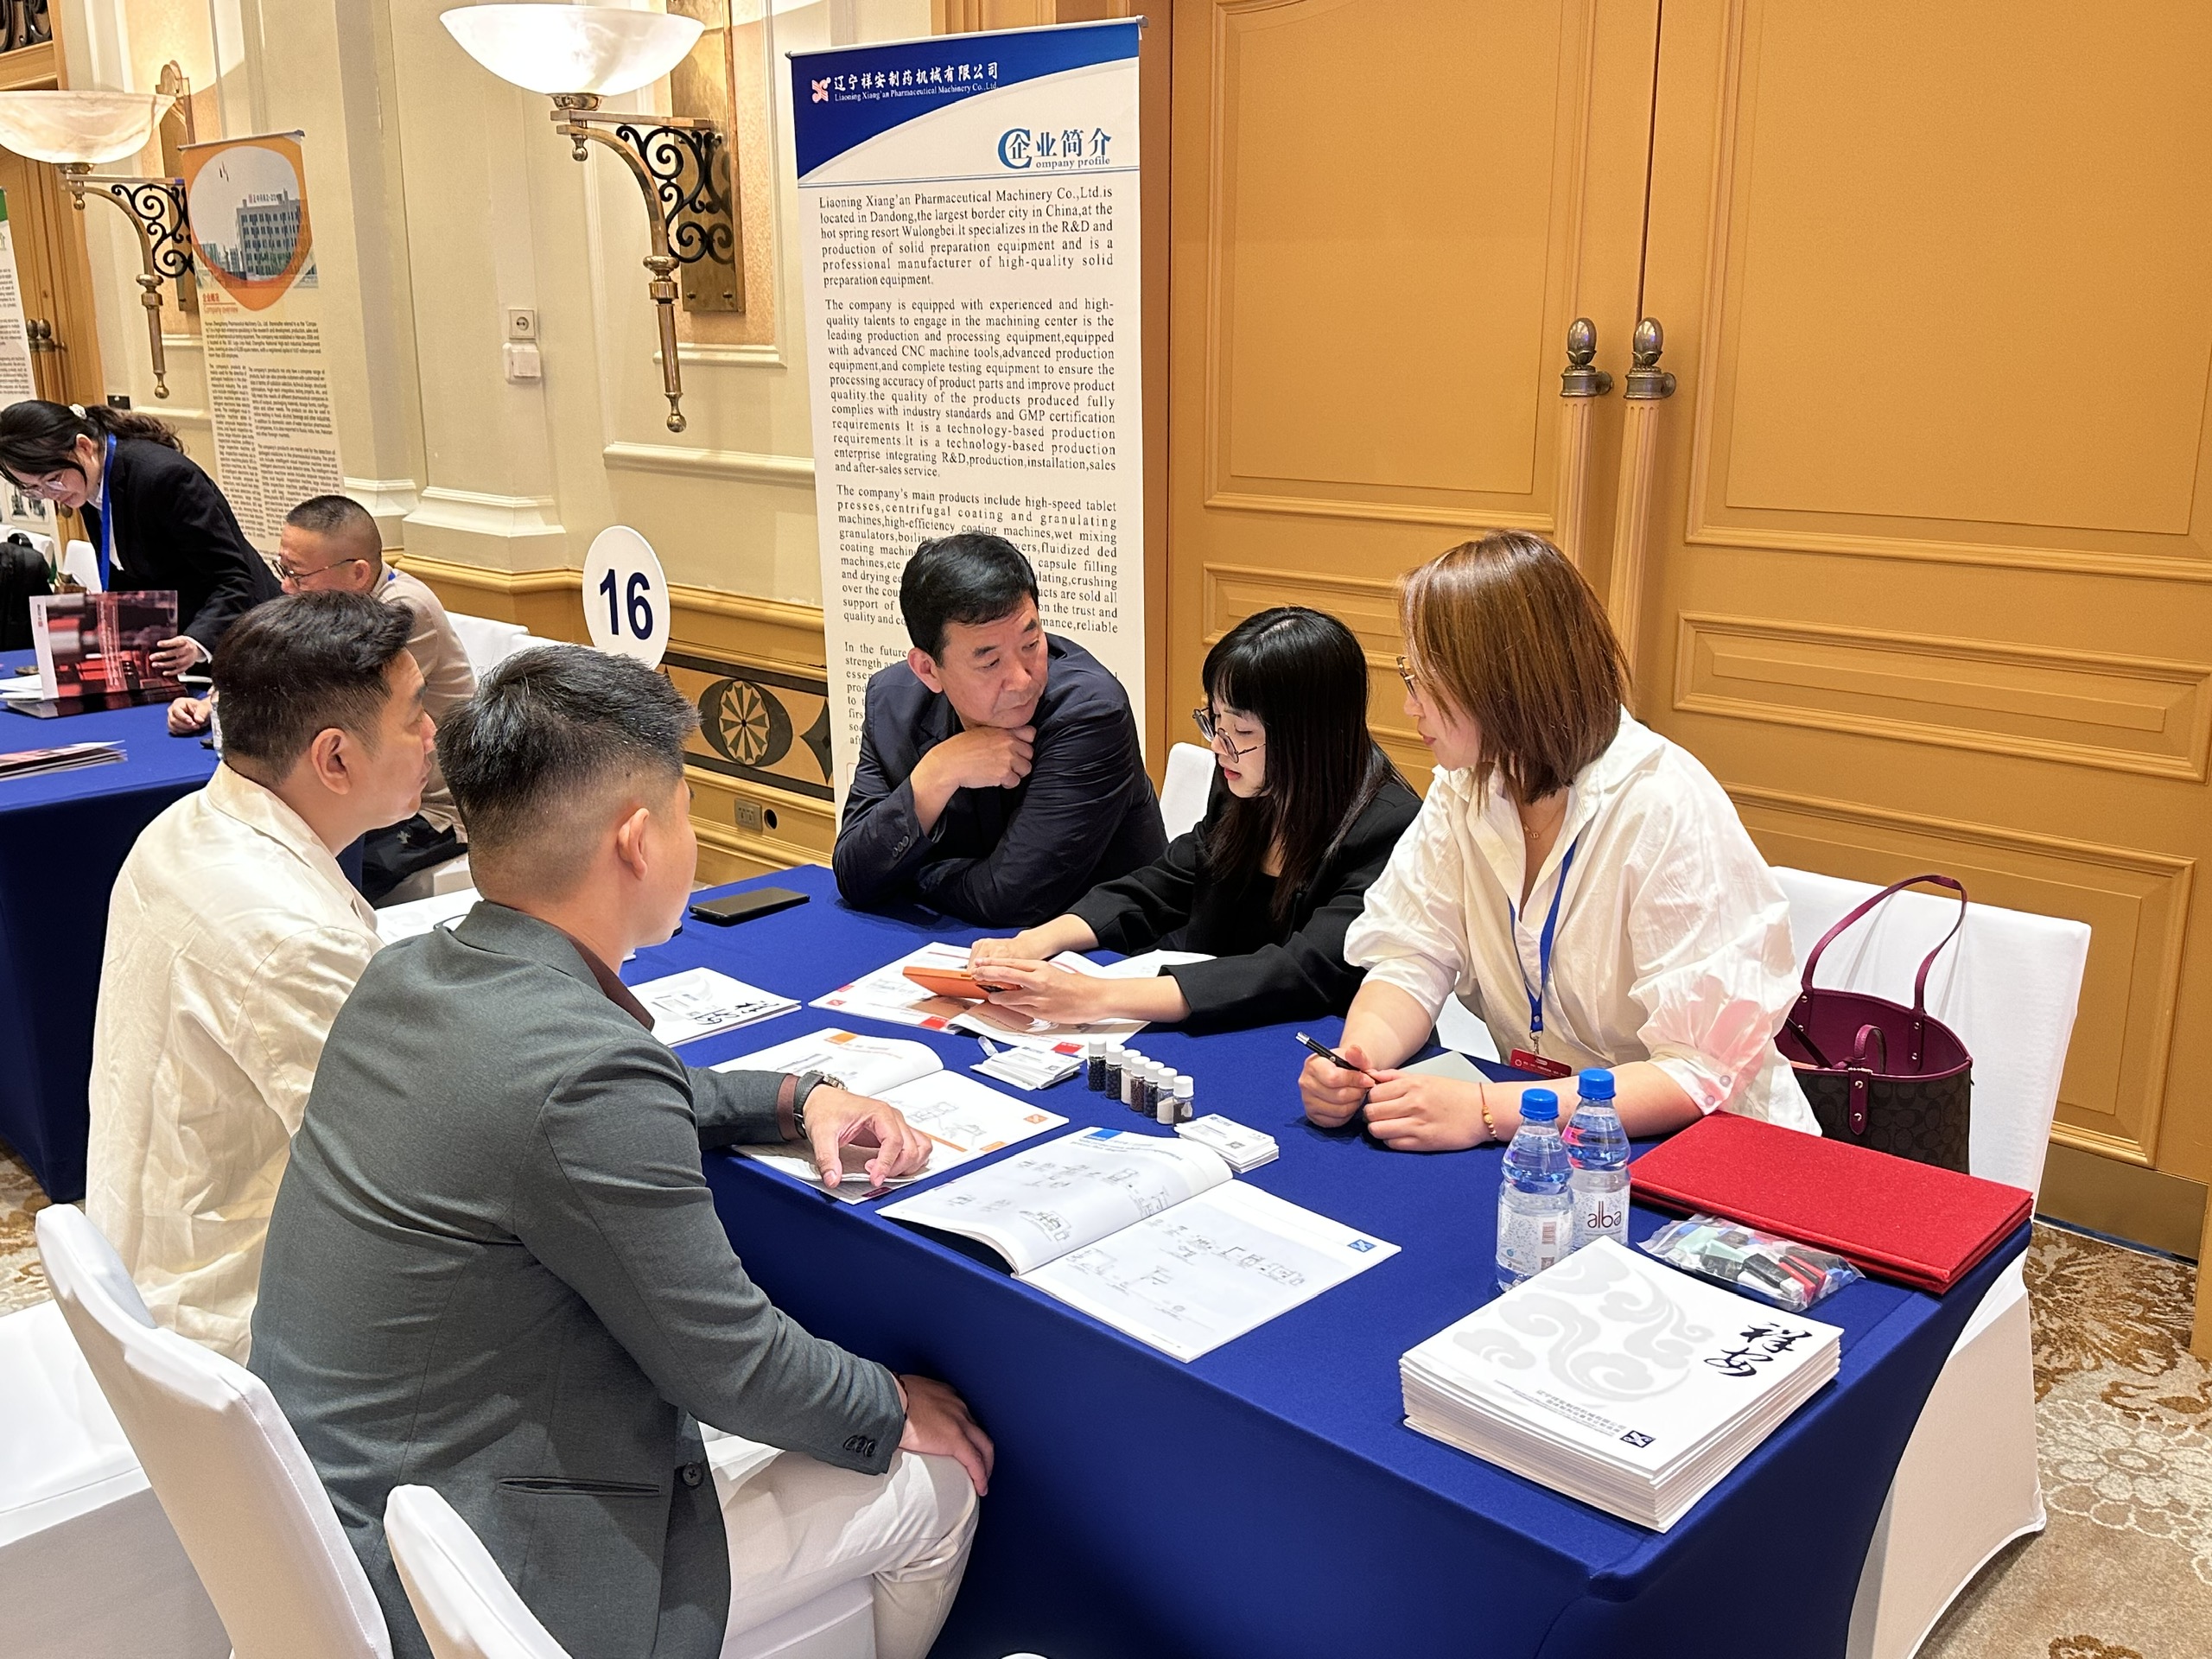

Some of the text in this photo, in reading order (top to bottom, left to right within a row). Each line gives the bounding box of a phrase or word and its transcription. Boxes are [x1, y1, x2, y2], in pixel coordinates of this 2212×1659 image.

[834, 62, 998, 92] 辽宁祥安制药机械有限公司
[835, 92, 861, 103] Liaoning
[890, 87, 938, 98] Pharmaceutical
[938, 84, 971, 94] Machinery
[1007, 128, 1112, 159] 企业简介
[1077, 156, 1110, 168] profile
[818, 195, 862, 210] Liaoning
[865, 194, 911, 208] Xiang'an
[914, 189, 991, 205] Pharmaceutical
[995, 188, 1052, 203] Machinery
[819, 201, 1112, 224] located in Dandong,the largest border city in China,at the
[820, 226, 836, 239] hot
[838, 226, 869, 241] spring
[870, 227, 899, 238] resort
[968, 221, 1025, 238] specializes
[1028, 220, 1039, 233] in
[1041, 220, 1058, 233] the
[1061, 219, 1090, 232] R&D
[1092, 219, 1112, 232] and
[821, 236, 1113, 258] production of solid preparation equipment and is a
[822, 252, 1113, 273] professional manufacturer of high-quality solid
[823, 273, 933, 289] preparation equipment.
[824, 296, 1114, 314] The company is equipped with experienced and high-
[825, 314, 1114, 329] quality talents to engage in the machining center is the
[827, 329, 1114, 345] leading production and processing equipment,equipped
[827, 344, 1114, 360] with advanced CNC machine tools,advanced production
[828, 359, 1114, 375] equipment,and complete testing equipment to ensure the
[829, 373, 1115, 392] processing accuracy of product parts and improve product
[891, 390, 927, 404] quality
[933, 391, 945, 403] of
[950, 391, 966, 404] the
[972, 391, 1020, 406] products
[1027, 393, 1079, 407] produced
[1087, 394, 1115, 409] fully
[831, 403, 1115, 423] complies with industry standards and GMP certification
[906, 420, 914, 431] It
[920, 423, 929, 432] is
[935, 424, 941, 433] a
[947, 422, 1044, 437] technology-based
[1051, 426, 1115, 439] production
[919, 438, 928, 447] is
[934, 439, 940, 448] a
[946, 436, 1044, 453] technology-based
[1051, 442, 1116, 455] production
[834, 448, 880, 461] enterprise
[885, 448, 937, 465] integrating
[835, 461, 851, 472] and
[853, 461, 902, 474] after-sales
[836, 483, 1116, 512] The company's main products include high-speed tablet
[836, 501, 1116, 530] presses,centrifugal coating and granulating
[961, 522, 997, 537] coating
[1003, 525, 1072, 540] machines,wet
[1078, 529, 1116, 544] mixing
[1096, 545, 1116, 557] ded
[1038, 558, 1117, 575] capsule filling
[860, 569, 890, 585] drying
[842, 584, 862, 594] over
[1078, 589, 1101, 601] sold
[600, 569, 653, 640] 16
[842, 598, 878, 610] support
[1071, 605, 1096, 616] trust
[843, 610, 875, 625] quality
[880, 645, 906, 658] future
[845, 656, 881, 670] strength
[1586, 1200, 1622, 1229] alba
